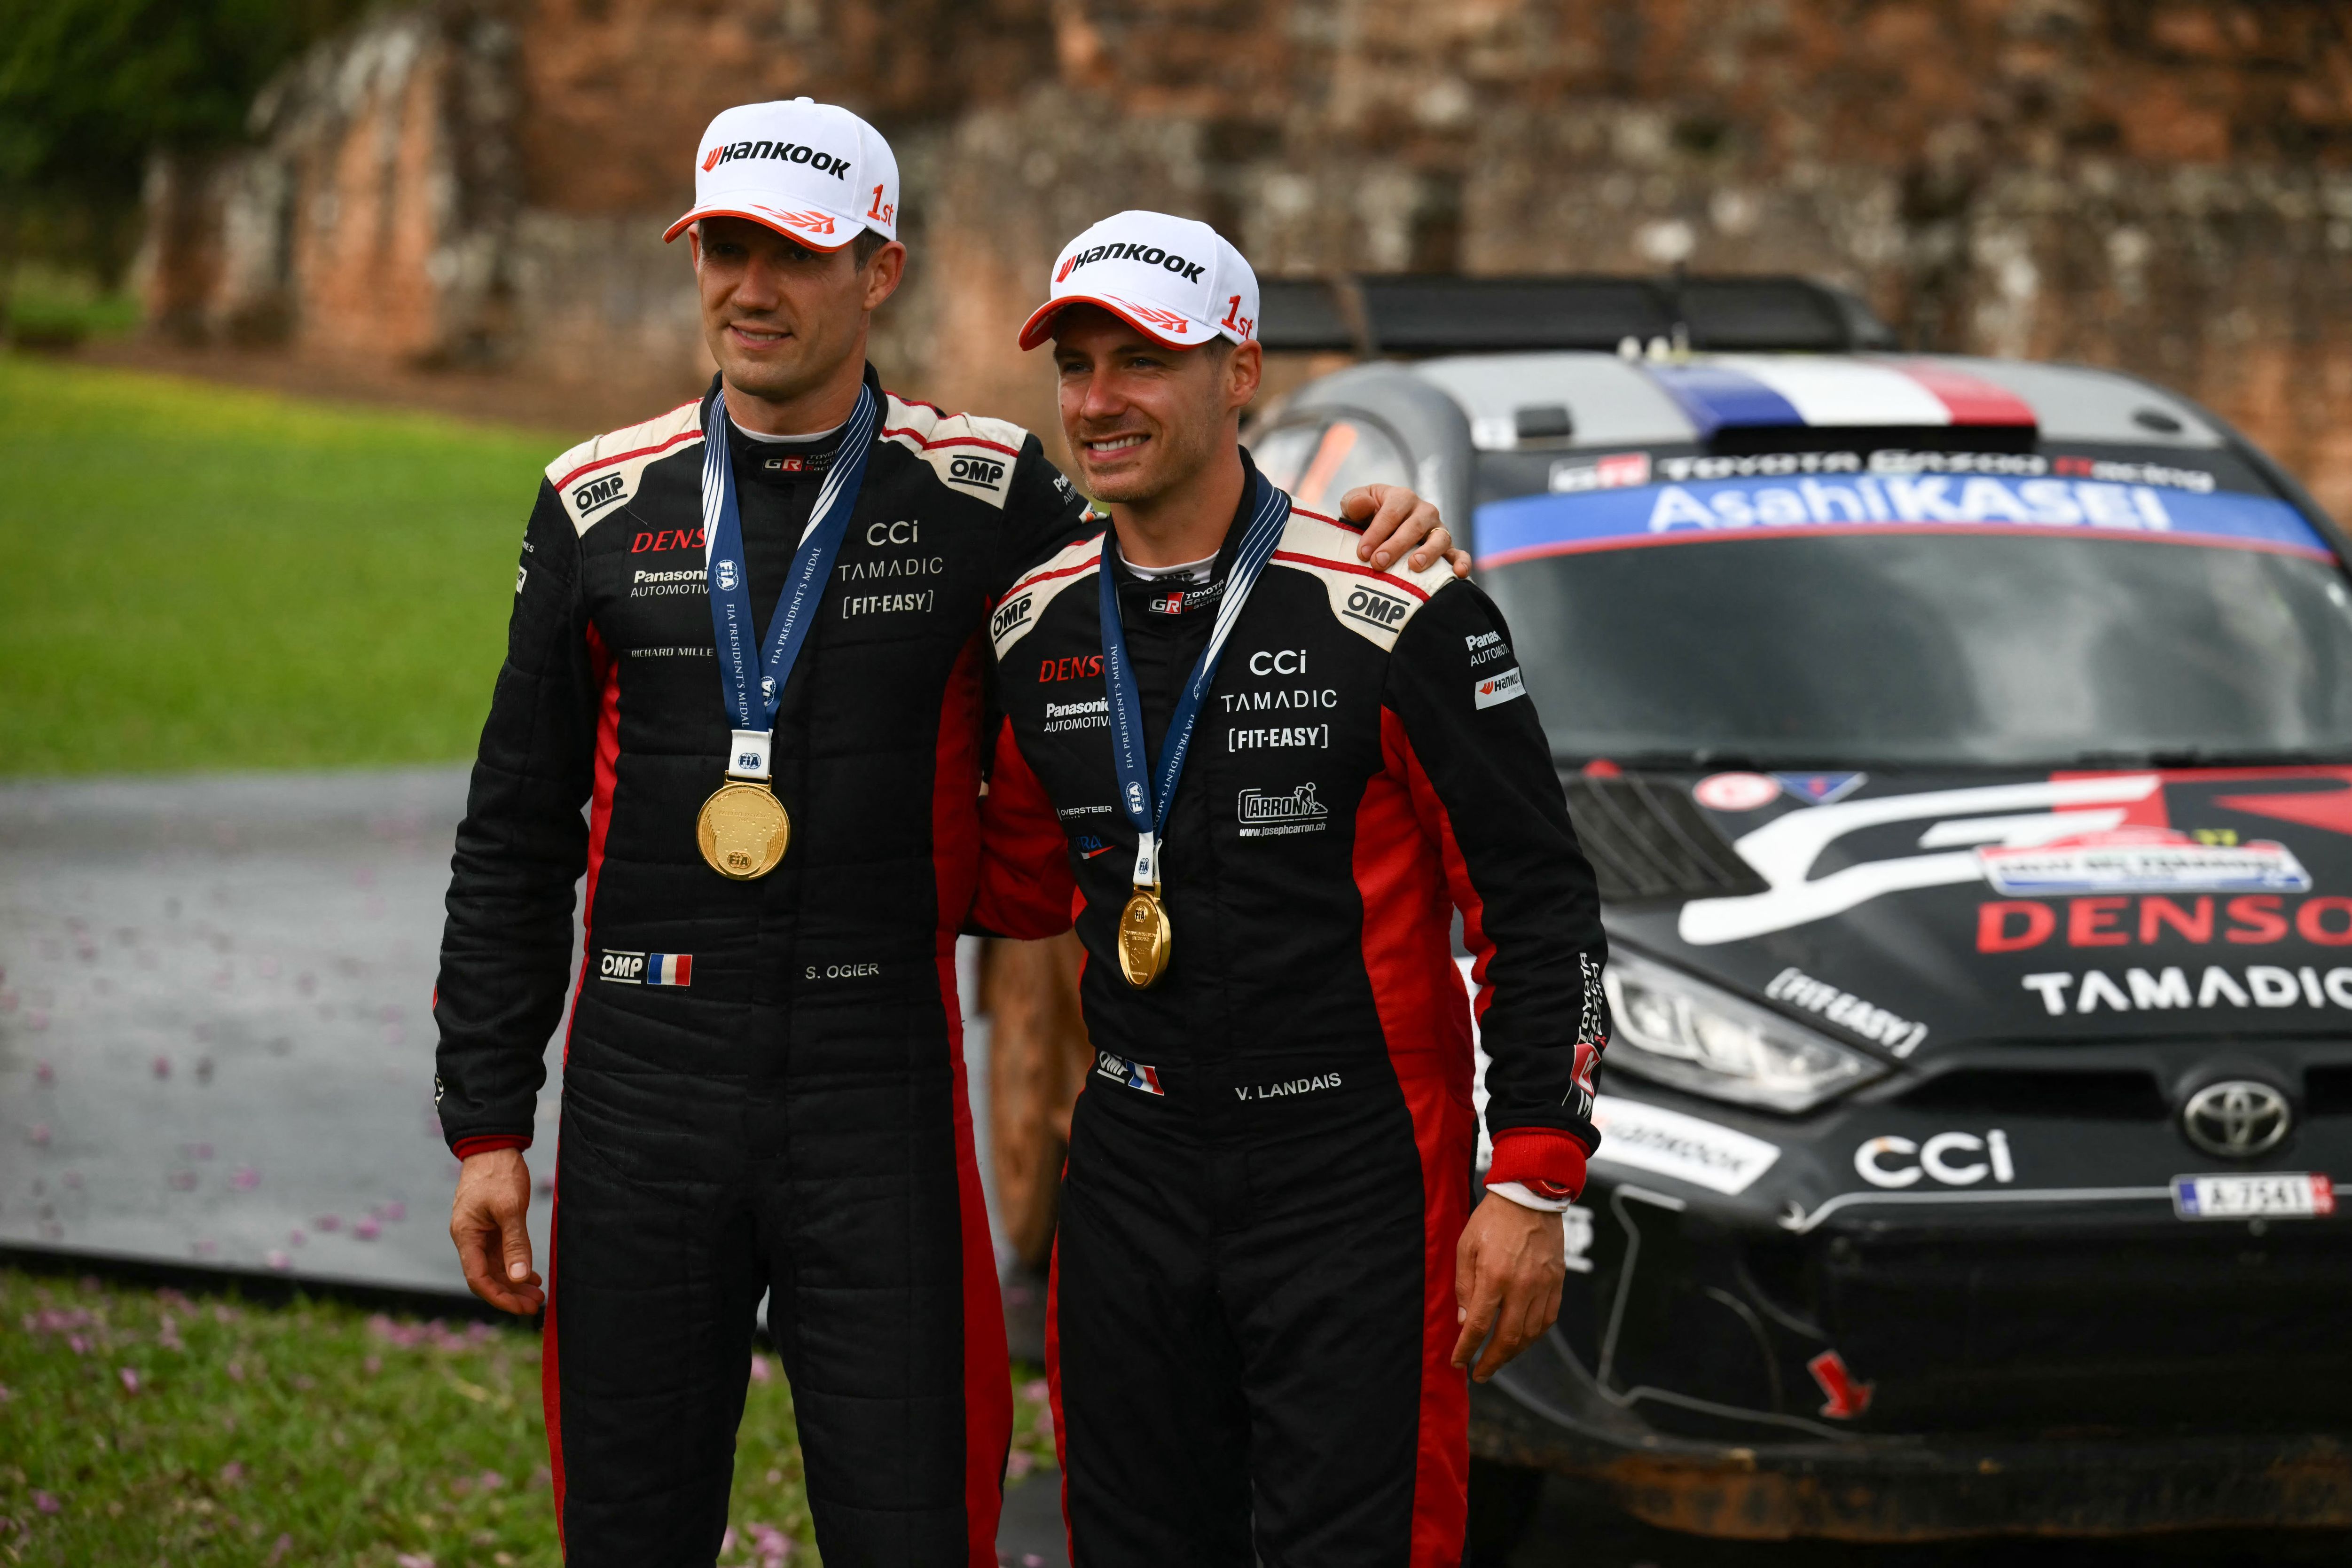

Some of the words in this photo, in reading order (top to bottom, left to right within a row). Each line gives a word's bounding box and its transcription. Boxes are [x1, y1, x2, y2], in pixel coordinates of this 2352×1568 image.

[867, 184, 894, 227] 1st
[1222, 295, 1253, 340] 1st
[765, 459, 801, 470] GR
[809, 448, 838, 459] TOYOT
[950, 459, 1004, 484] OMP
[576, 476, 624, 510] OMP
[631, 527, 706, 553] DENS
[634, 569, 708, 583] Panasoni
[838, 557, 943, 581] TAMADIC
[630, 583, 709, 598] AUTOMOTIV
[1186, 579, 1224, 599] TOYOTA
[726, 604, 735, 621] FIA
[771, 645, 782, 664] FIA
[779, 583, 808, 644] PRESIDENT'S
[800, 548, 821, 581] MEDAL
[993, 598, 1032, 635] OMP
[1152, 599, 1180, 612] GR
[1347, 591, 1406, 626] OMP
[631, 647, 673, 658] RICHARD
[678, 647, 714, 657] MILLE
[1465, 630, 1501, 651] Panas
[729, 623, 745, 690] PRESIDENT'S
[1039, 655, 1106, 682] DENS
[737, 691, 751, 728] MEDAL
[1221, 689, 1338, 713] TAMADIC
[1044, 715, 1111, 733] AUTOMOTIV
[1114, 683, 1130, 750] PRESIDENT'S
[739, 755, 760, 768] FIA
[1162, 733, 1190, 797] PRESIDENT'S
[1060, 806, 1113, 816] OVERSTEER
[1239, 822, 1326, 837] www.josephcarron.ch
[1976, 894, 2352, 954] DENSO
[601, 954, 643, 978] OMP
[805, 965, 821, 980] S.
[826, 963, 879, 978] OGIER
[1235, 1086, 1253, 1101] V.
[1258, 1072, 1342, 1098] LANDAIS
